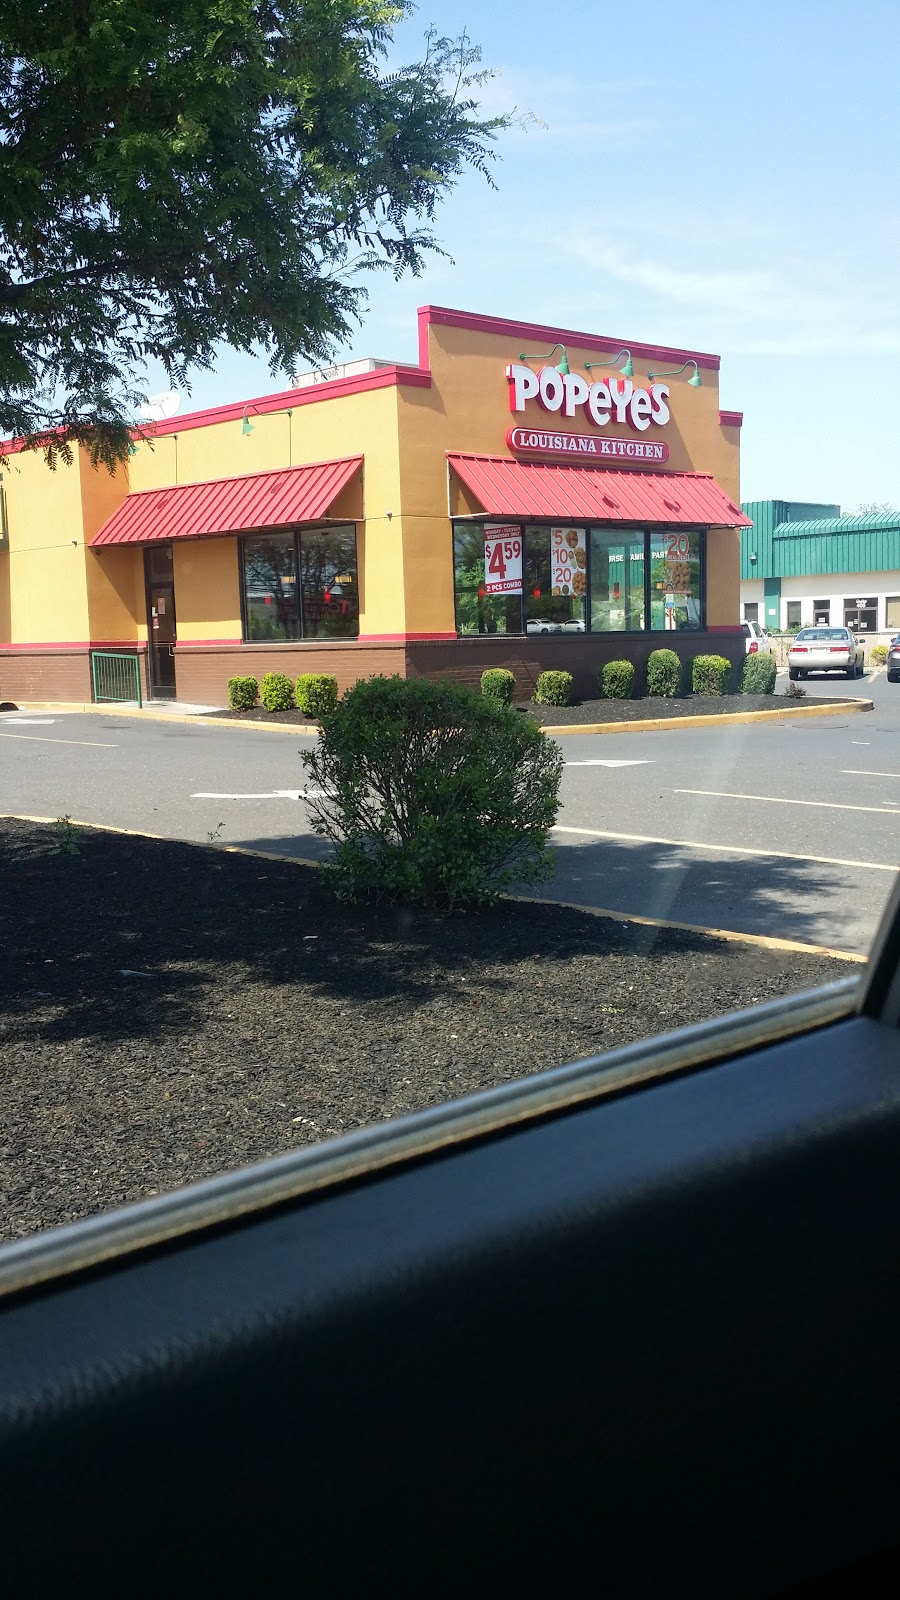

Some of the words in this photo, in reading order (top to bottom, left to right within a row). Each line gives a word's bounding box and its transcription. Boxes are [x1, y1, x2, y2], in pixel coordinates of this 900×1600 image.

[519, 432, 596, 453] LOUISIANA
[600, 441, 664, 459] KITCHEN
[491, 583, 503, 591] PCS
[503, 580, 522, 589] COMBO
